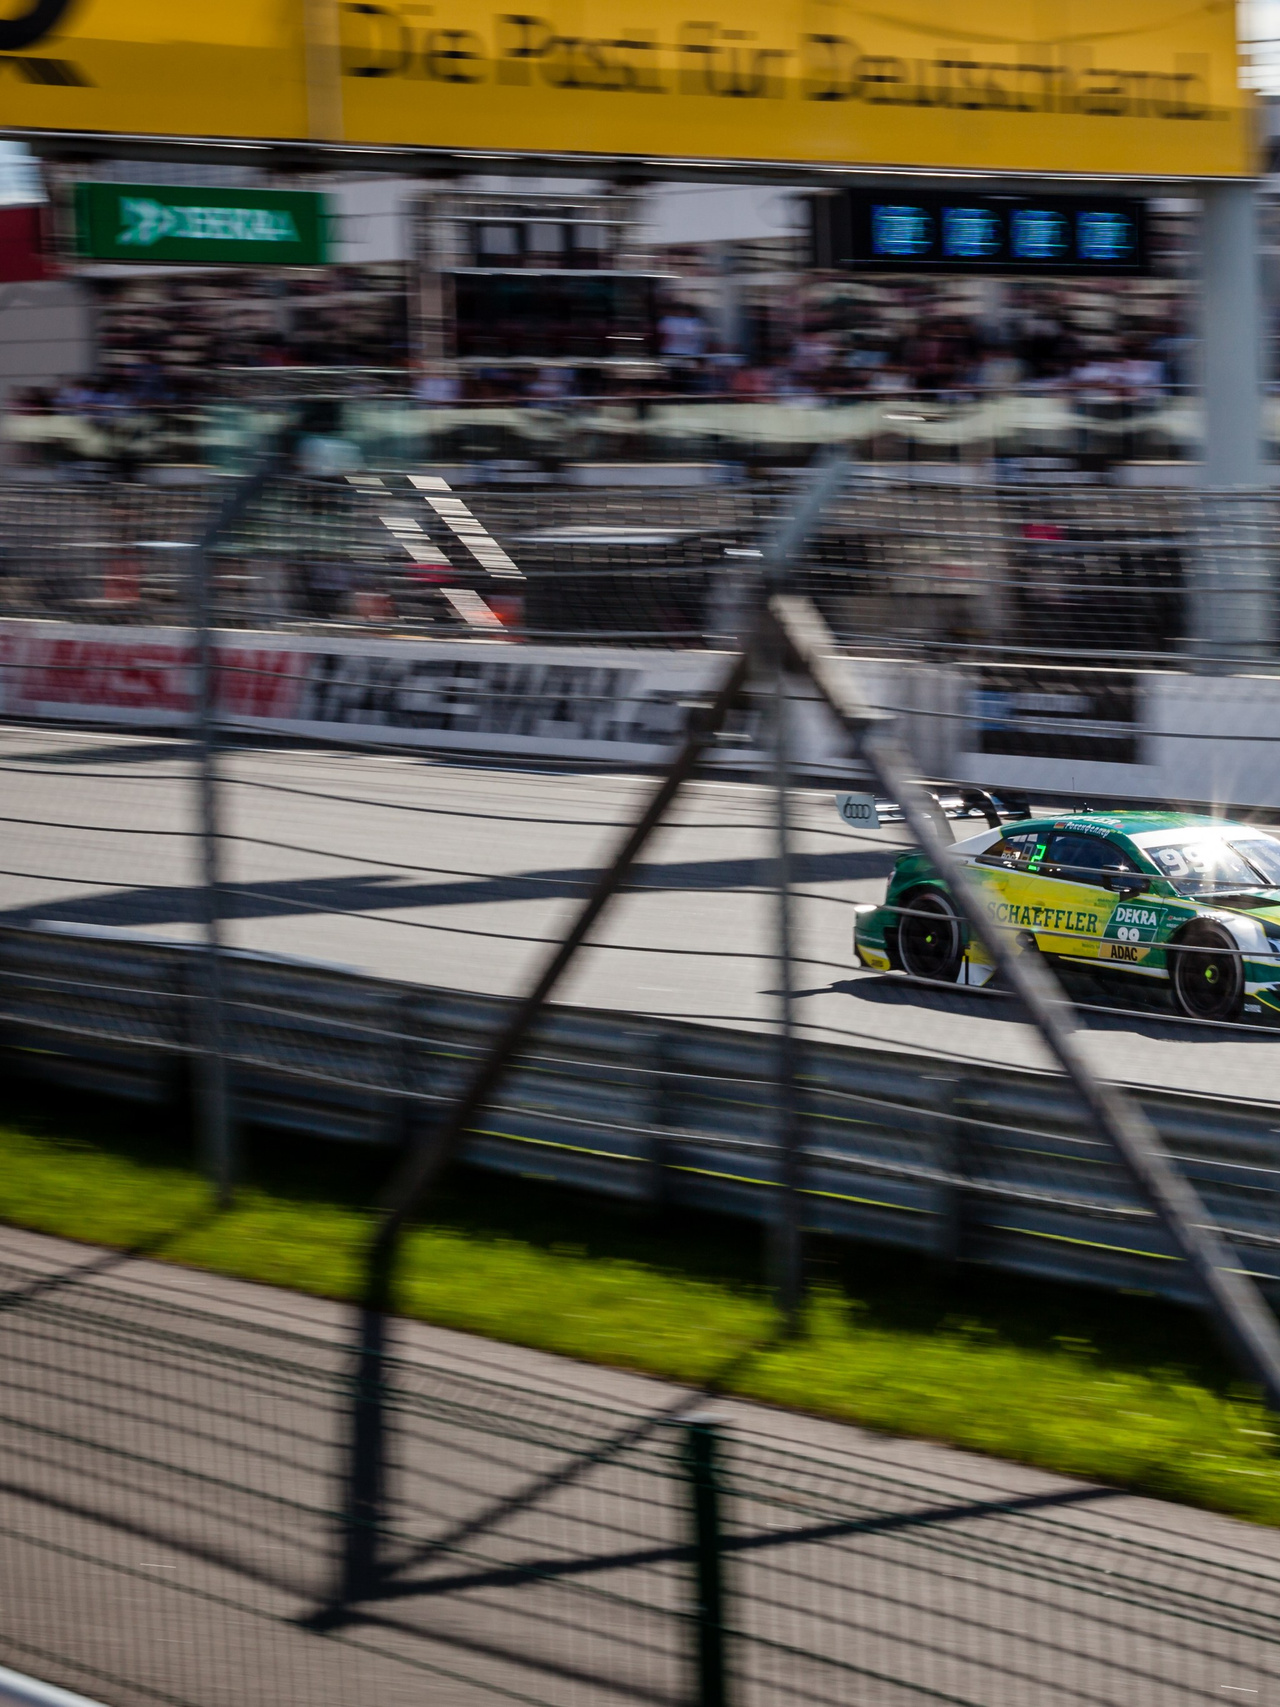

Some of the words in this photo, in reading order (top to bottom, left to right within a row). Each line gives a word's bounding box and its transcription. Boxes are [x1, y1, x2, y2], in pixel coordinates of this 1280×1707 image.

[338, 2, 487, 84] Die
[494, 12, 672, 95] Post
[1158, 846, 1214, 877] 99
[987, 901, 1098, 933] SCHAEFFLER
[1116, 907, 1157, 926] DEKRA
[1111, 945, 1138, 961] ADAC
